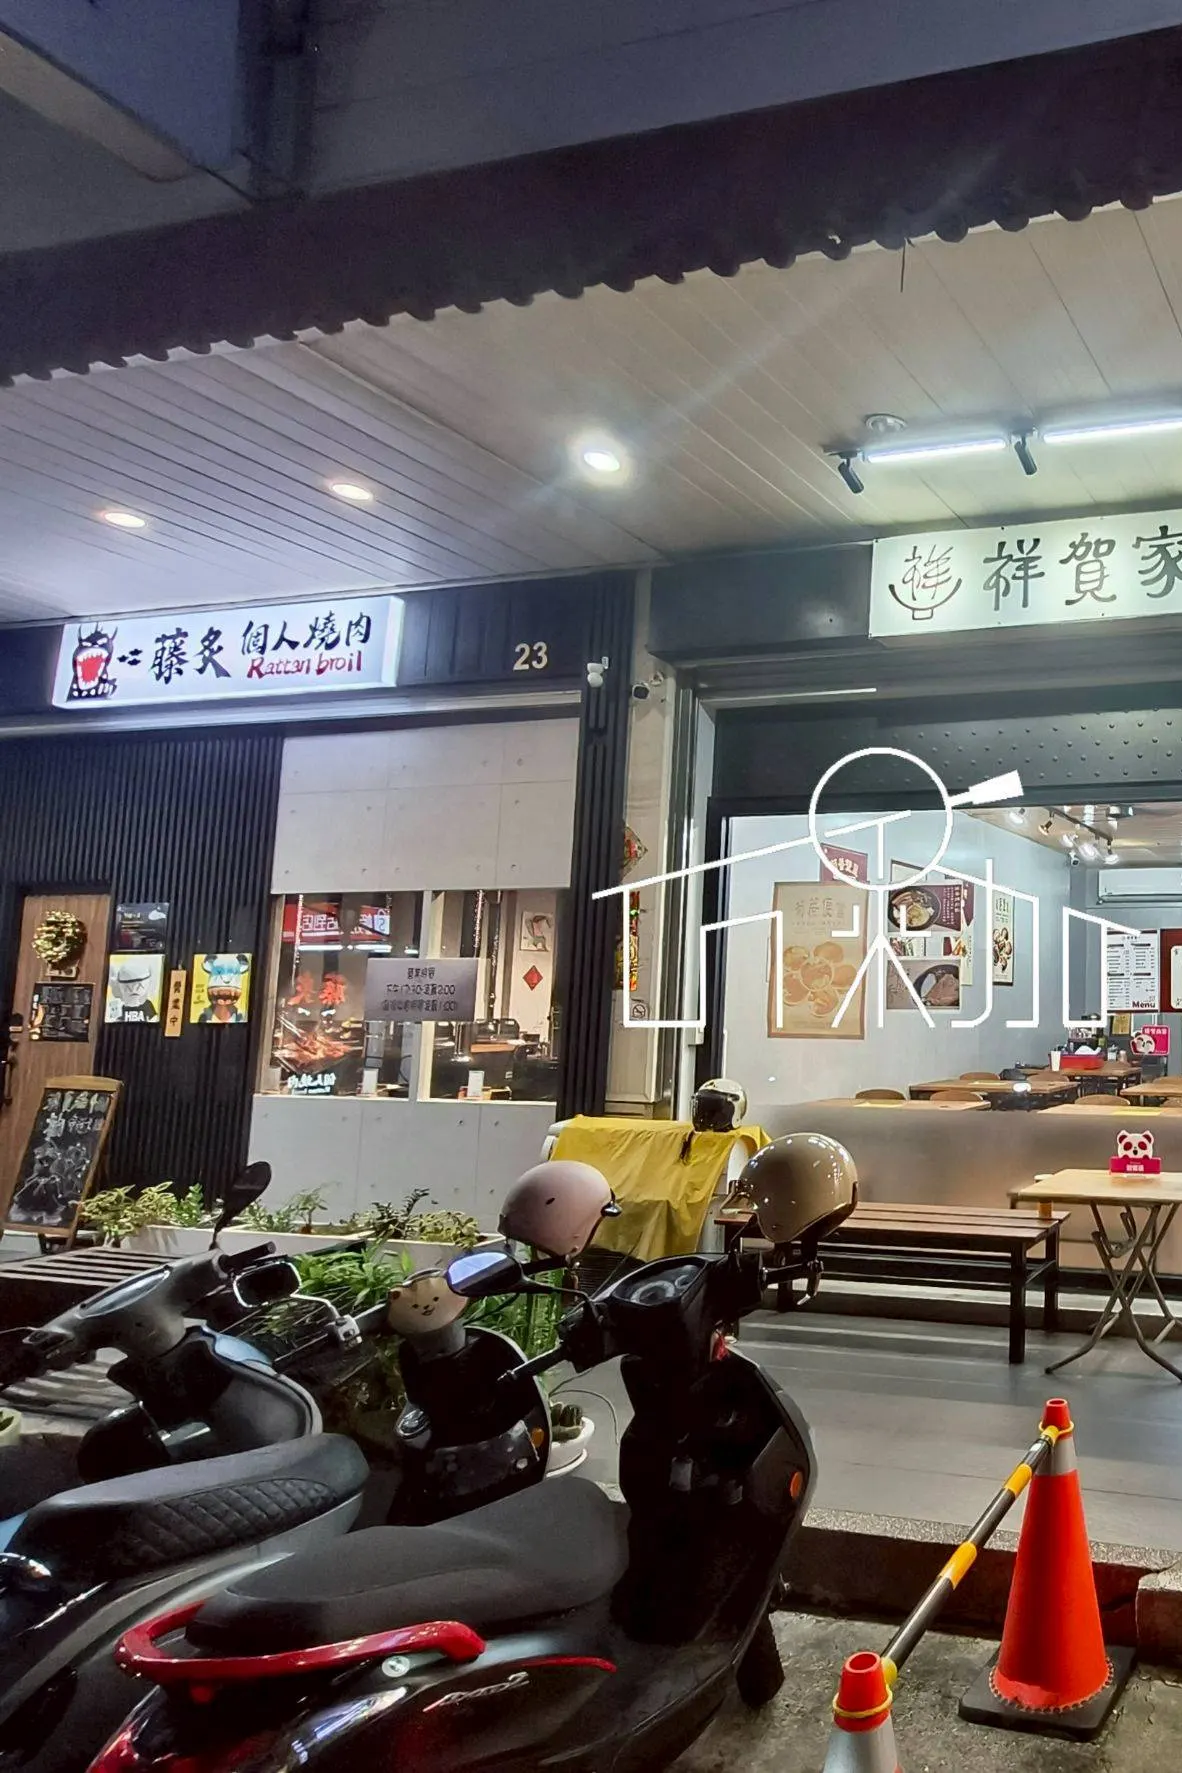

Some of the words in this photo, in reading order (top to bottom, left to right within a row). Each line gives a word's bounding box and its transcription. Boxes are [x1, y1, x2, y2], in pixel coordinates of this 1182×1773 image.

[241, 610, 371, 655] 個人燒肉
[247, 656, 311, 679] Rattan
[316, 651, 362, 675] broil
[514, 642, 549, 671] 23
[125, 1010, 145, 1023] HBA
